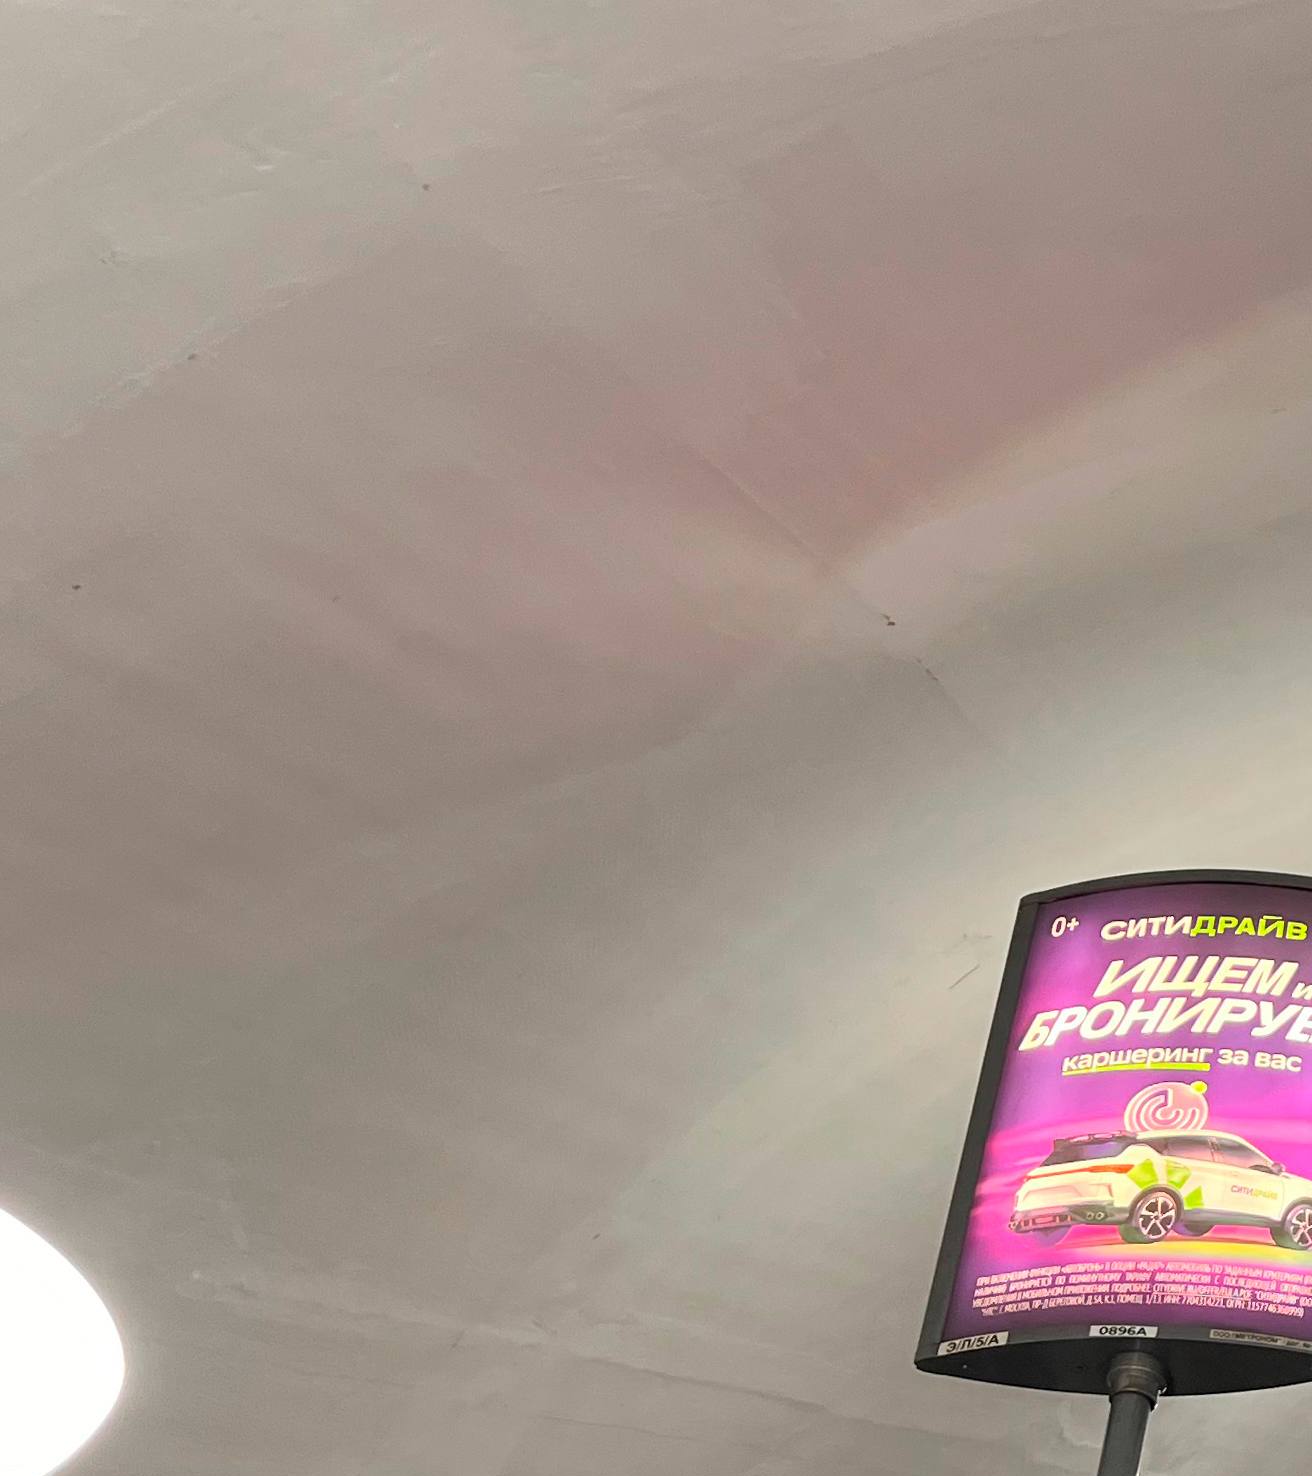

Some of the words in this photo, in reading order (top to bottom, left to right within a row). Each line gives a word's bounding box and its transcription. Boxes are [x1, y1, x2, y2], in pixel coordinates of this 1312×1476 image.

[1051, 915, 1080, 937] 0+
[1100, 915, 1308, 941] СИТИДРАЙВ
[1093, 955, 1299, 998] ИЩЕМ
[1062, 1047, 1213, 1072] каршеринг
[1217, 1048, 1248, 1066] за
[1254, 1051, 1303, 1072] вас
[1099, 1326, 1147, 1336] 0896А
[946, 1334, 999, 1353] Э/П/5/А
